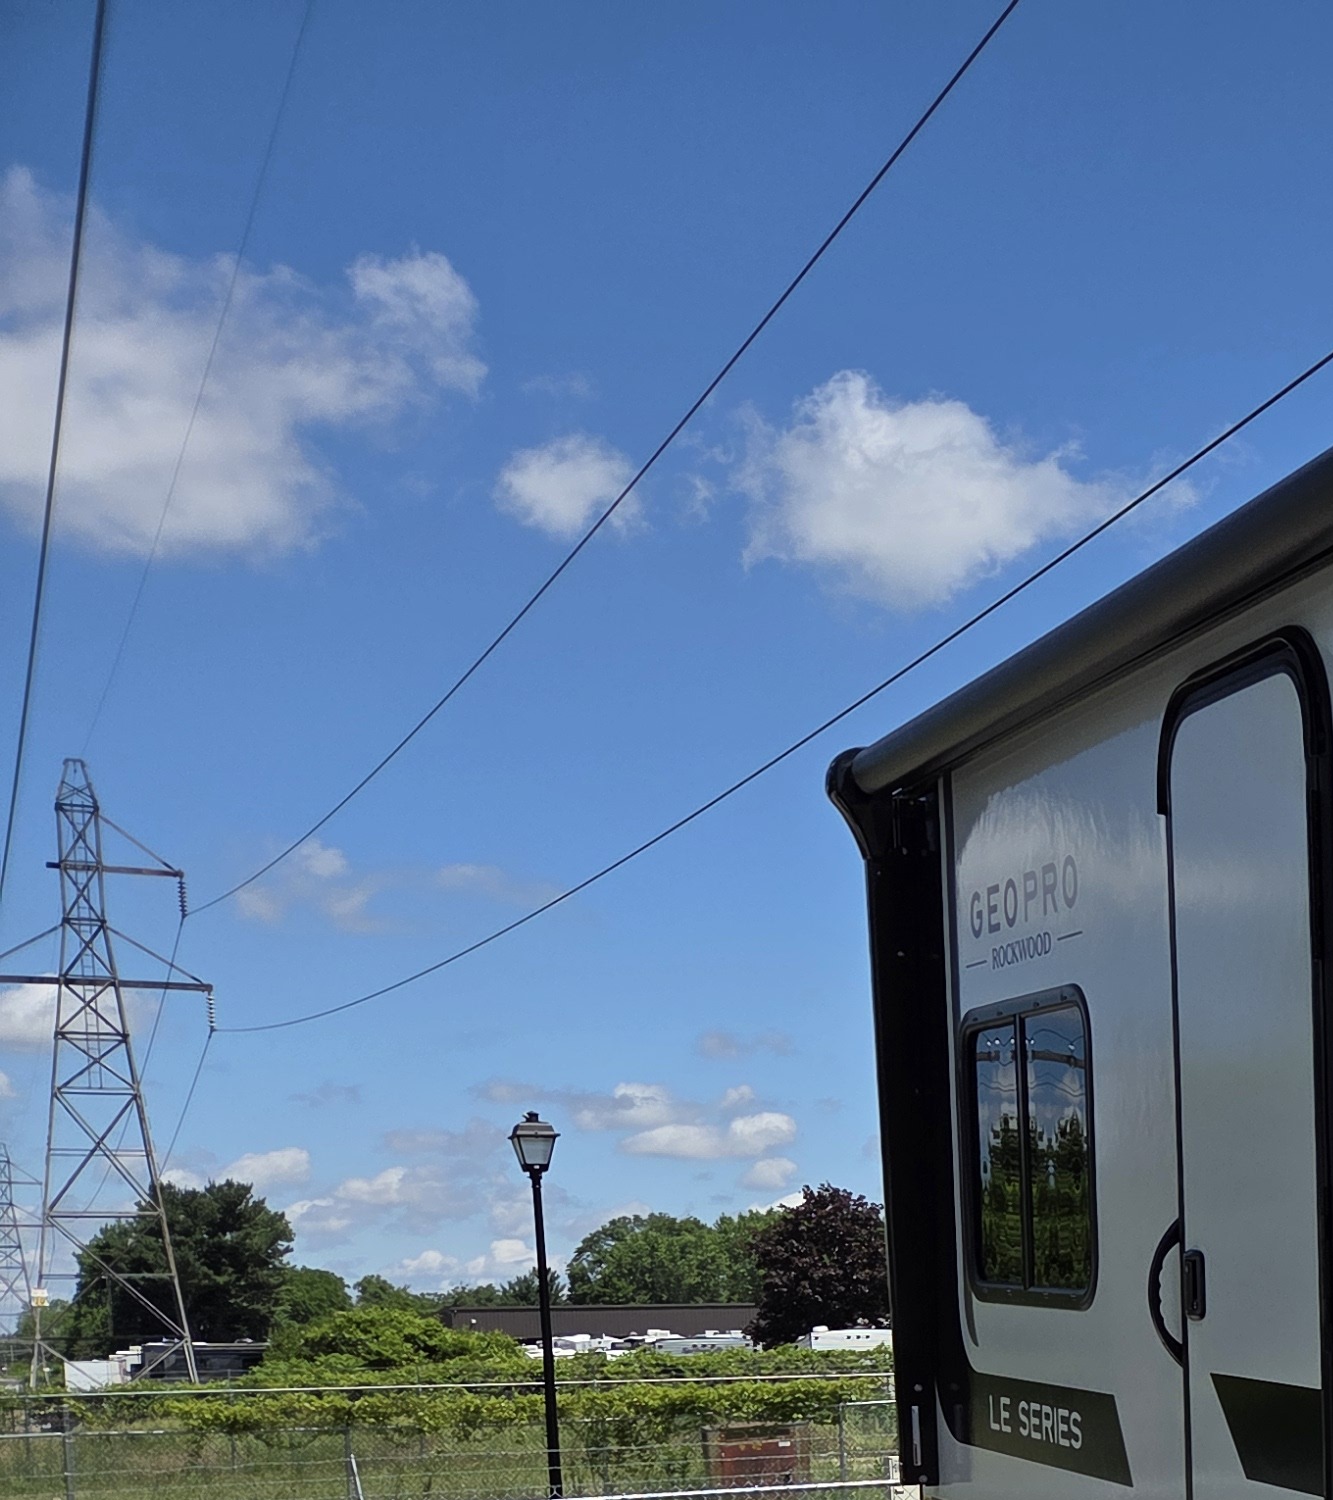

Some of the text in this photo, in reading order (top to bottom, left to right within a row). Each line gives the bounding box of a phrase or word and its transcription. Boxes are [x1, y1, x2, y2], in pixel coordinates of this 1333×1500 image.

[970, 854, 1078, 939] GEOPRO
[991, 931, 1052, 970] ROCKWOOD
[988, 1394, 1083, 1450] LE SERIES
